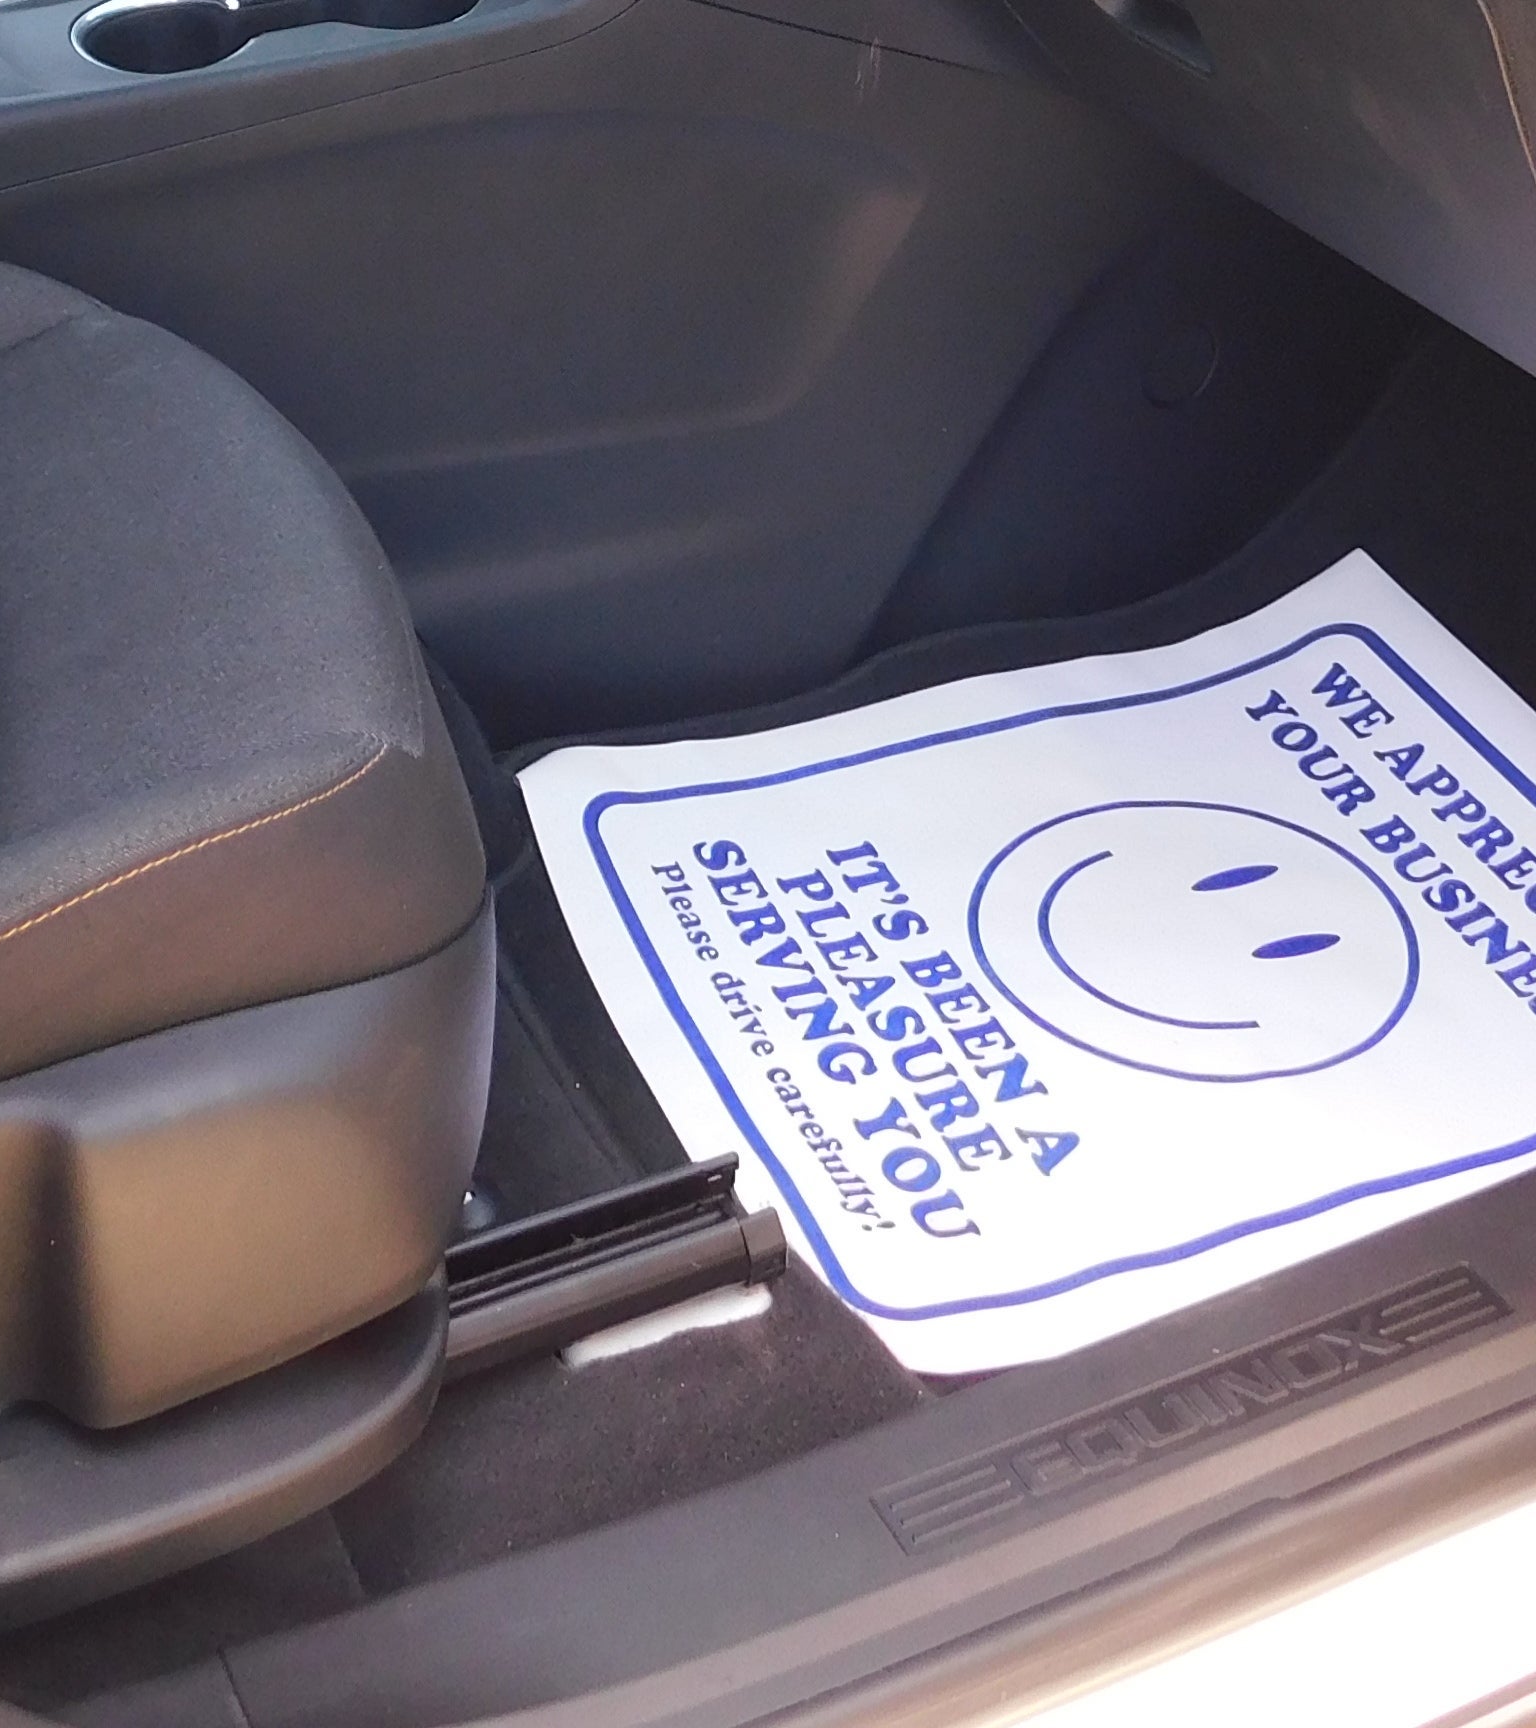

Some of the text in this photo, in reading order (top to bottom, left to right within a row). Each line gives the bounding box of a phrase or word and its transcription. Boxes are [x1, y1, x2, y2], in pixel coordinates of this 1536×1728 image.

[1244, 689, 1376, 816] YOUR
[1311, 662, 1395, 739] WE
[650, 861, 897, 1233] Please drive carefully!
[692, 839, 982, 1239] SERVING YOU
[776, 869, 1013, 1172] PLEASURE
[825, 840, 1080, 1177] IT'S BEEN A
[1010, 1318, 1404, 1498] EQUINOX
